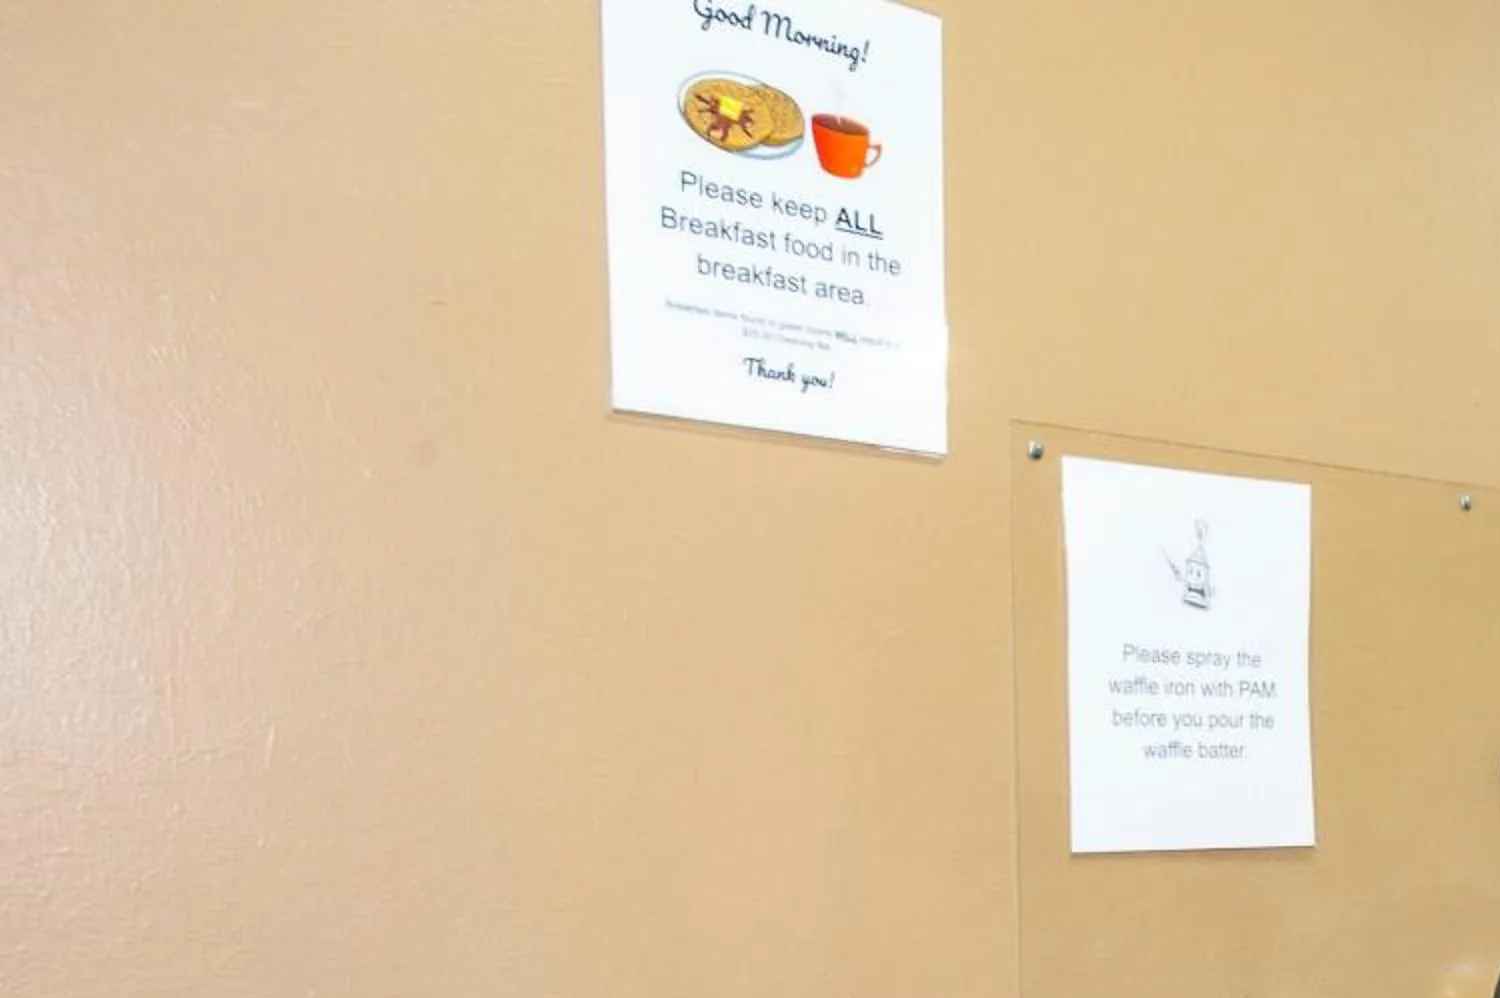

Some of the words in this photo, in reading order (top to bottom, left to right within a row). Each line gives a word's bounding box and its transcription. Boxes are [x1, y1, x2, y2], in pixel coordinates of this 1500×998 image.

[693, 0, 756, 31] Good
[762, 10, 870, 72] Morning!
[679, 170, 763, 209] Please
[771, 191, 827, 226] keep
[835, 207, 884, 240] ALL
[661, 206, 777, 251] Breakfast
[783, 233, 834, 262] food
[841, 245, 861, 267] in
[867, 252, 901, 276] the
[697, 254, 808, 295] breakfast
[742, 357, 796, 383] Thank
[801, 371, 836, 393] you!
[1123, 644, 1181, 664] Please
[1187, 650, 1231, 671] spray
[1237, 648, 1262, 668] the
[1108, 676, 1160, 697] waffle
[1164, 678, 1195, 697] iron
[1200, 679, 1234, 697] with
[1239, 680, 1277, 699] PAM
[1112, 708, 1167, 728] before
[1172, 713, 1203, 731] you
[1208, 711, 1244, 732] pour
[1249, 711, 1275, 729] the
[1143, 740, 1193, 760] waffle
